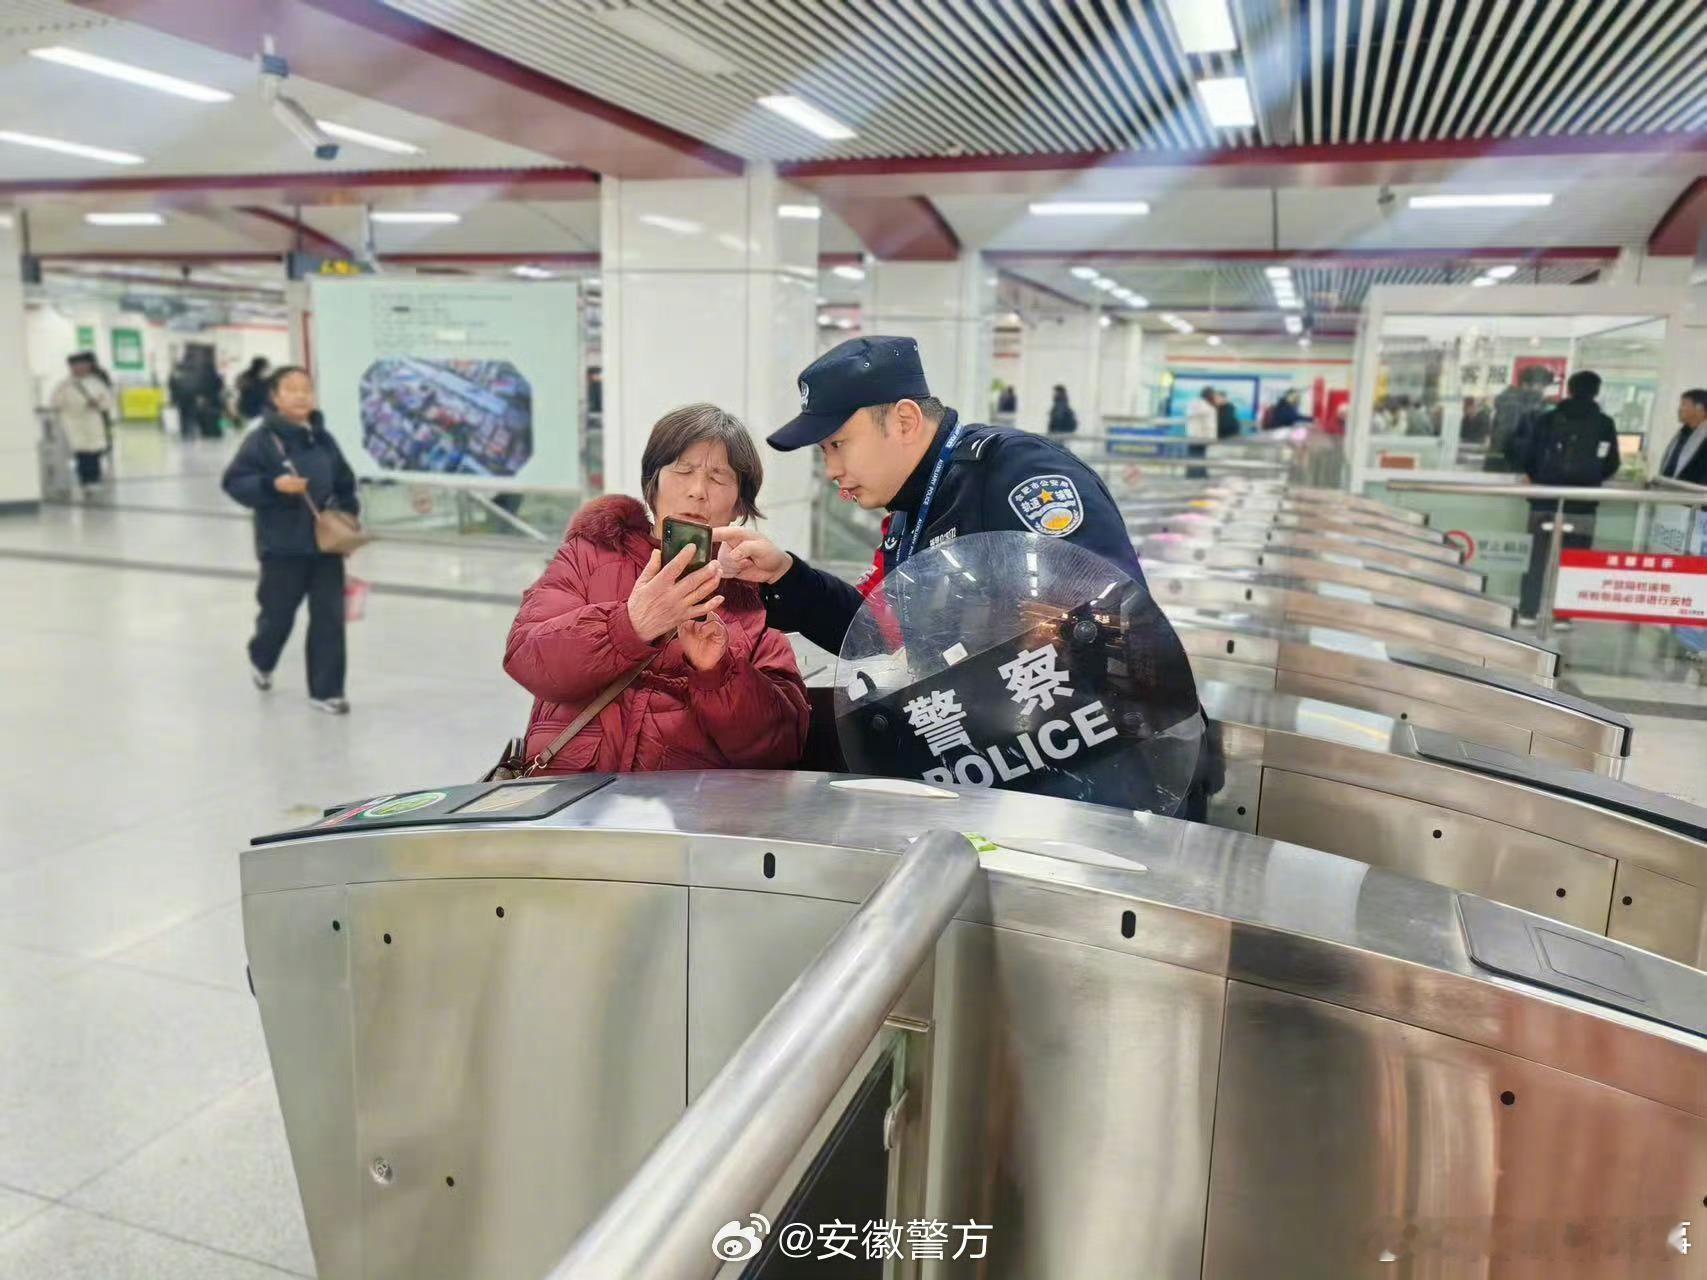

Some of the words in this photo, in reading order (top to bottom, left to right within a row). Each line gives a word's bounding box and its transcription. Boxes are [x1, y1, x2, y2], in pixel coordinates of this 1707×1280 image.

[923, 484, 935, 506] POLICE
[902, 643, 1075, 757] 警察
[921, 700, 1119, 788] POLICE
